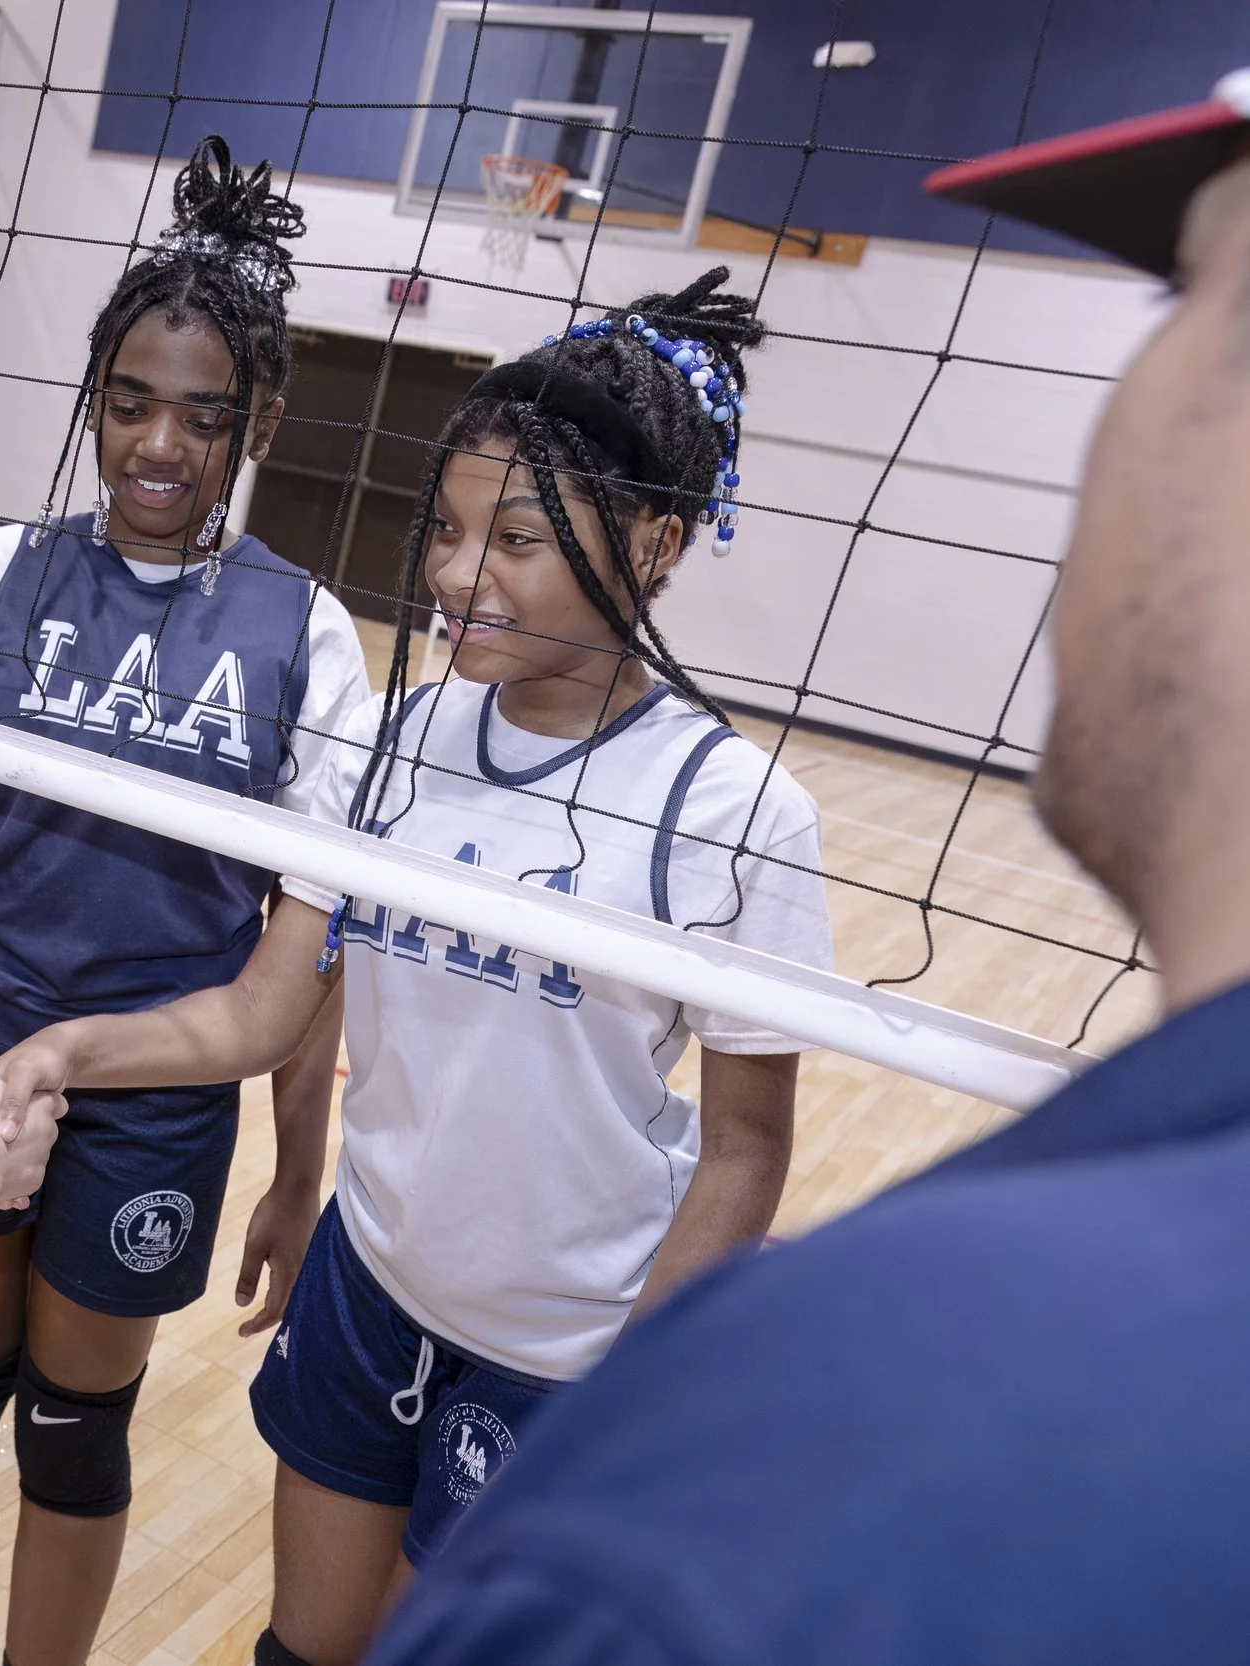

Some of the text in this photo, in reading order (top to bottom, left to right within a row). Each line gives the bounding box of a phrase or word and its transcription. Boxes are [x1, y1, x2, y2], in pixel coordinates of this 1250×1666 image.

[18, 618, 253, 770] LAA
[117, 1195, 161, 1229] LITHONIA
[122, 1252, 171, 1269] ACADEMY
